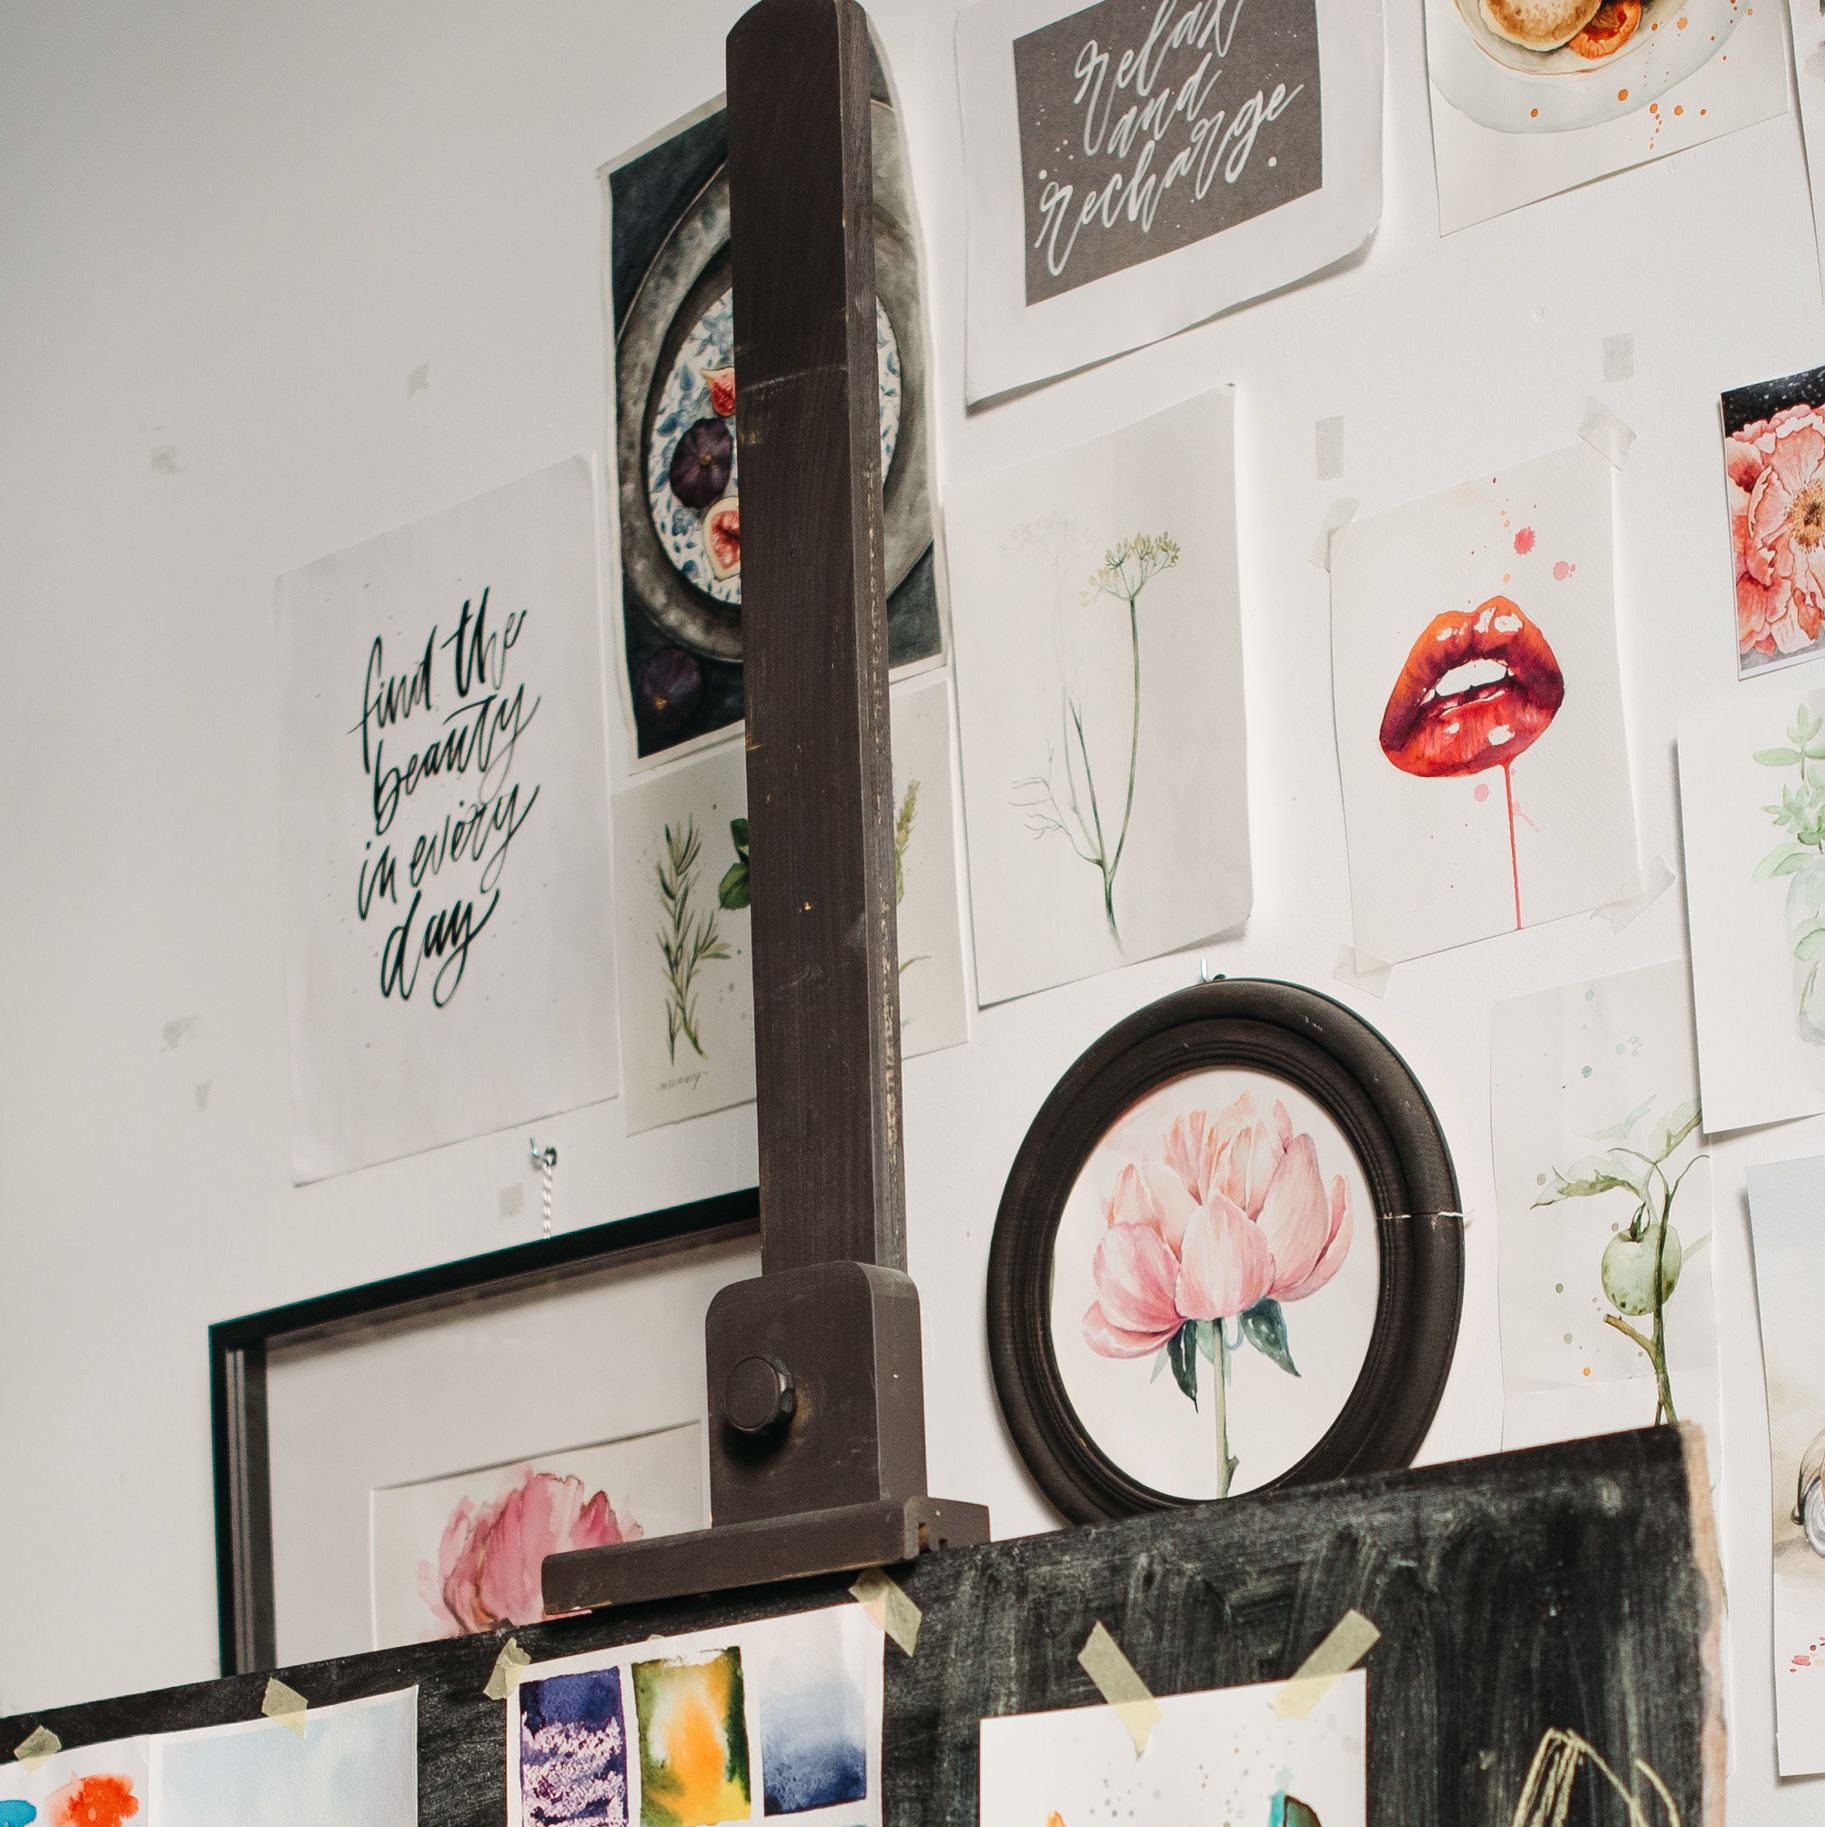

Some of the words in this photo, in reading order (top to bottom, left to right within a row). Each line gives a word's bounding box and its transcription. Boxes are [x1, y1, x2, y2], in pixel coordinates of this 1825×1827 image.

[1107, 52, 1223, 158] and
[1034, 83, 1305, 276] recharge
[348, 624, 438, 775] find
[441, 586, 527, 698] the
[372, 684, 541, 835] beauty
[357, 840, 398, 921] in
[409, 783, 541, 894] every
[380, 888, 500, 1008] day
